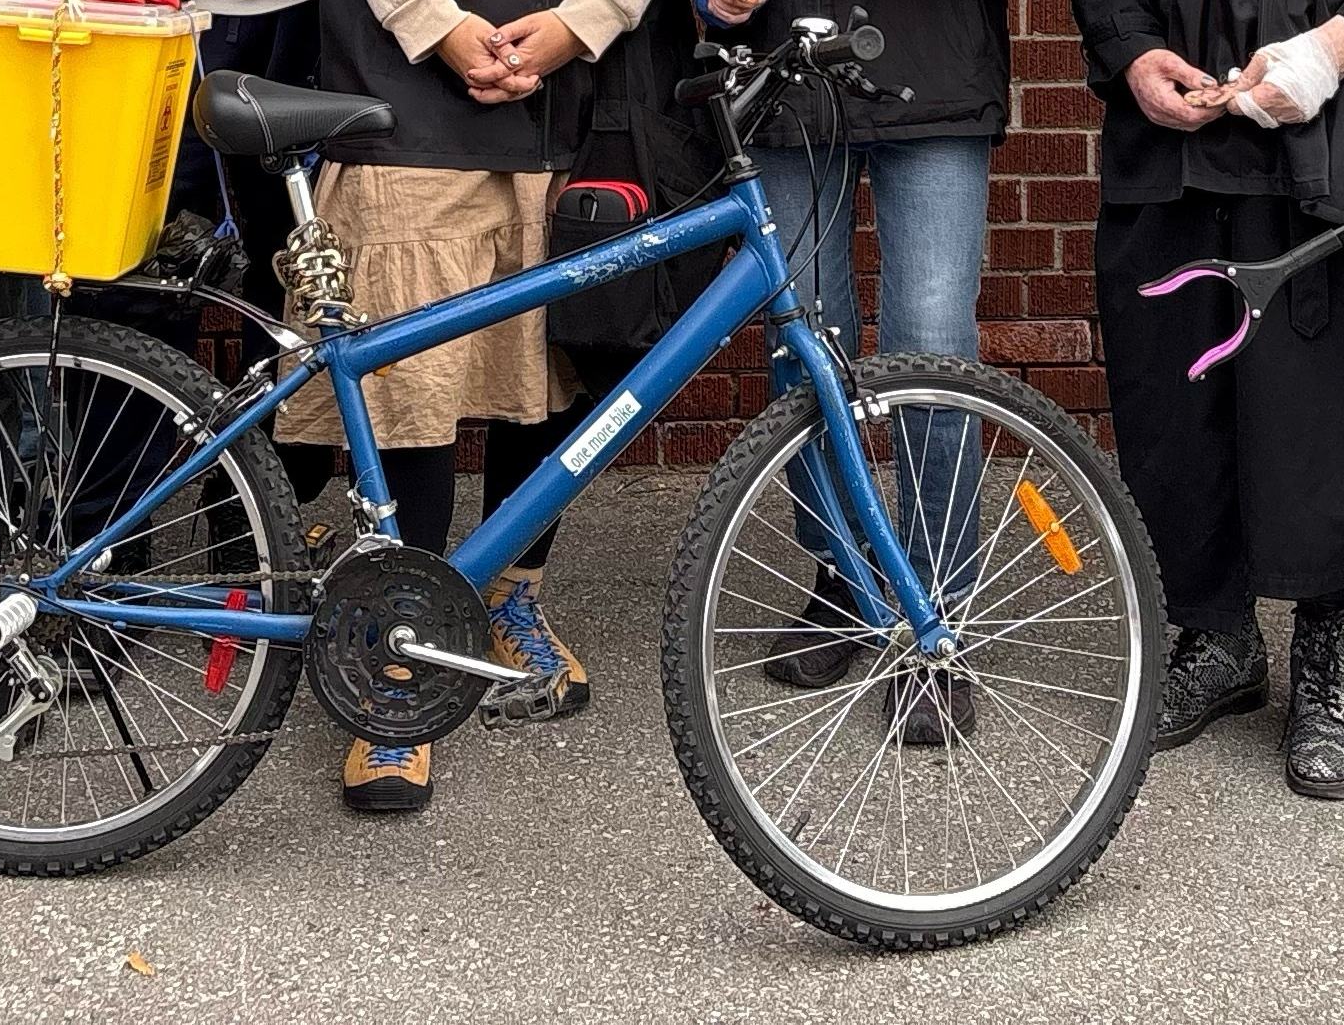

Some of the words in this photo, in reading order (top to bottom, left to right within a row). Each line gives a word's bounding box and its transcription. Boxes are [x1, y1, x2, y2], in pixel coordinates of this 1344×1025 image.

[570, 447, 592, 469] one
[587, 422, 616, 452] more
[609, 403, 636, 428] bike
